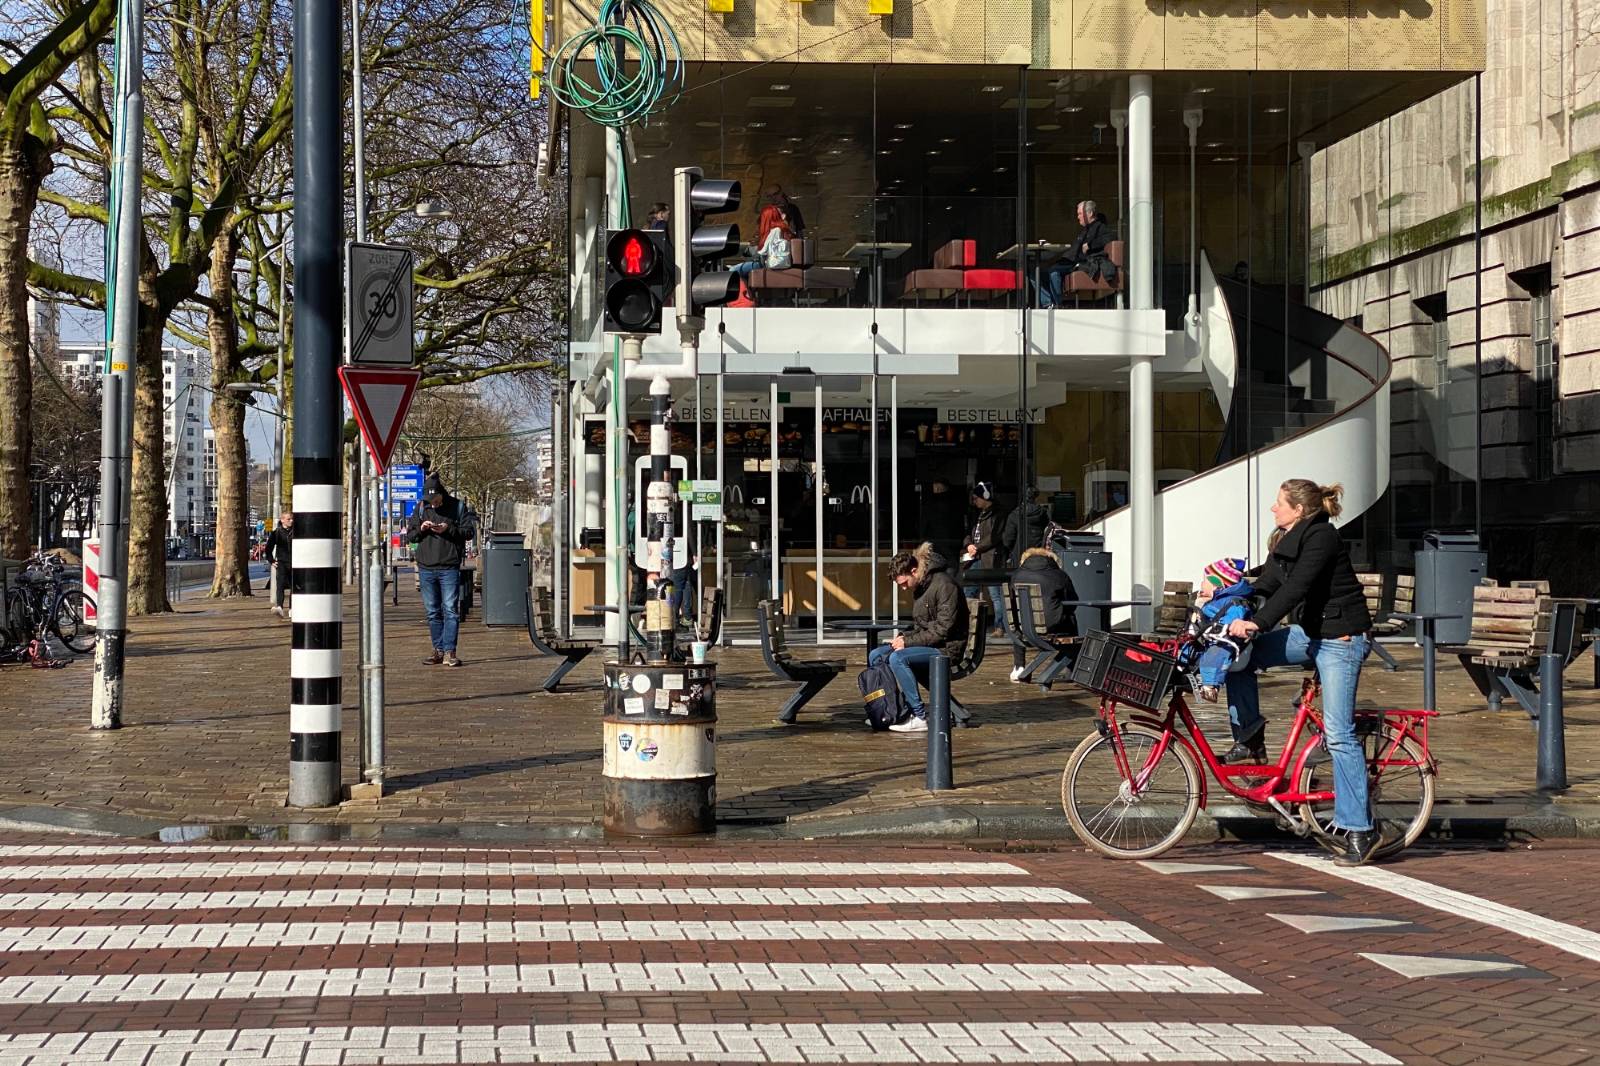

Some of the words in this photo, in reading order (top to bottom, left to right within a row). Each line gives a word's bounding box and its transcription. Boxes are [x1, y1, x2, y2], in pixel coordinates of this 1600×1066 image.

[369, 253, 396, 266] ZONE
[368, 291, 397, 318] 30
[822, 408, 893, 422] AFHALEN
[947, 409, 1036, 422] BESTELLEN
